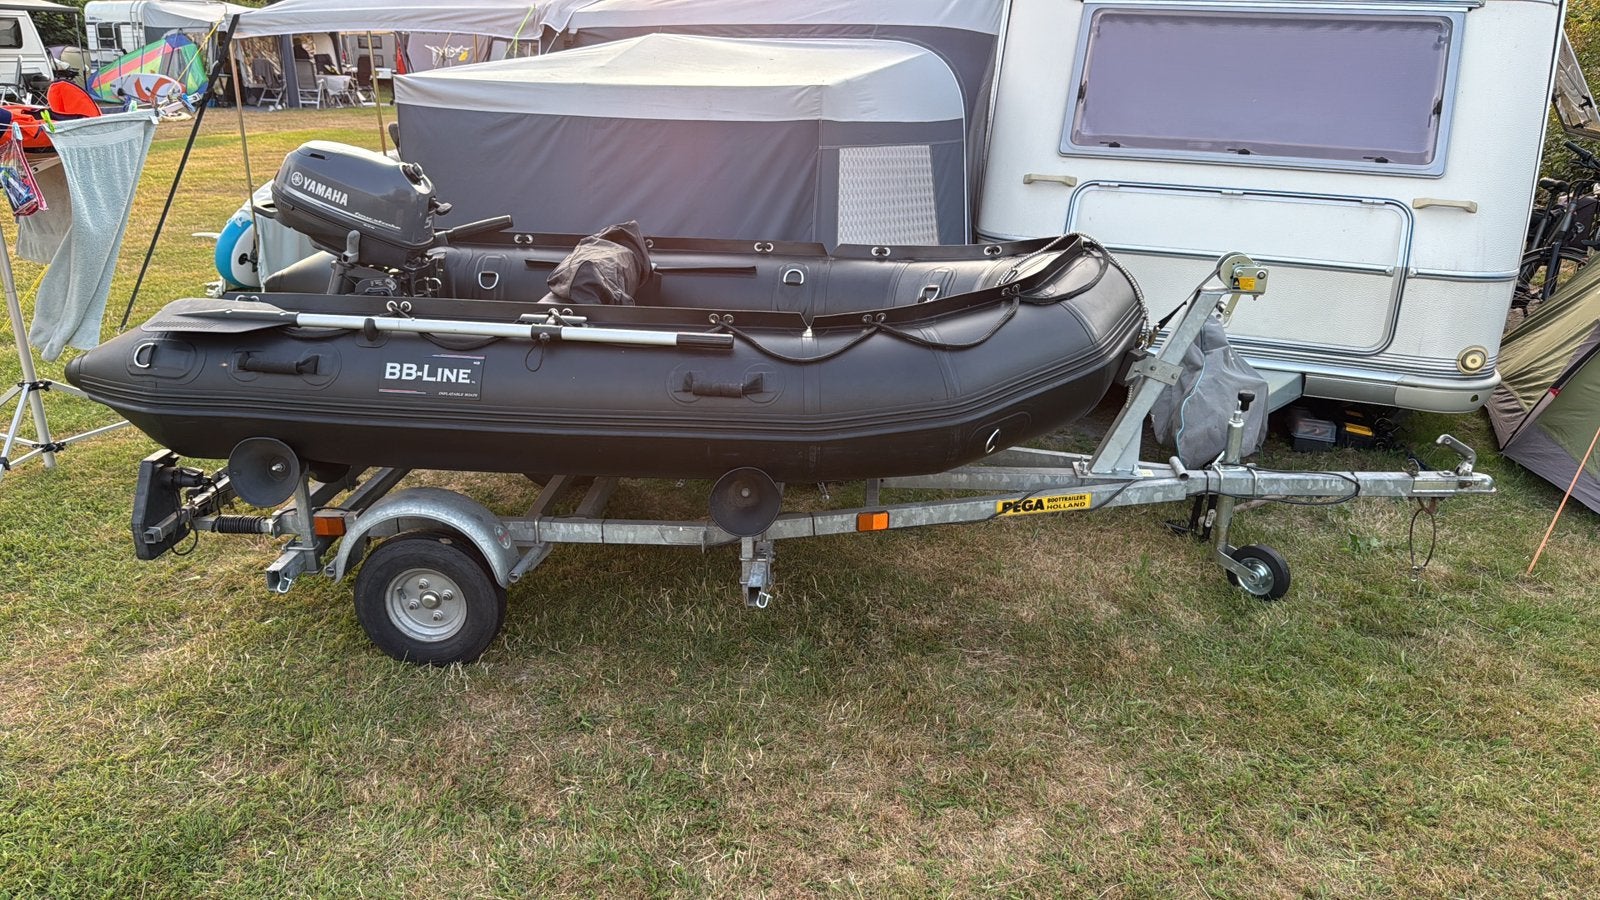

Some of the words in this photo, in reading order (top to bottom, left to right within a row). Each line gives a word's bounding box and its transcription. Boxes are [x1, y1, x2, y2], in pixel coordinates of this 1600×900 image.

[302, 176, 349, 207] YAMAHA
[1047, 495, 1087, 503] BOOTTRAILERS
[1001, 498, 1045, 513] PEGA
[1046, 501, 1086, 510] HOLLAND
